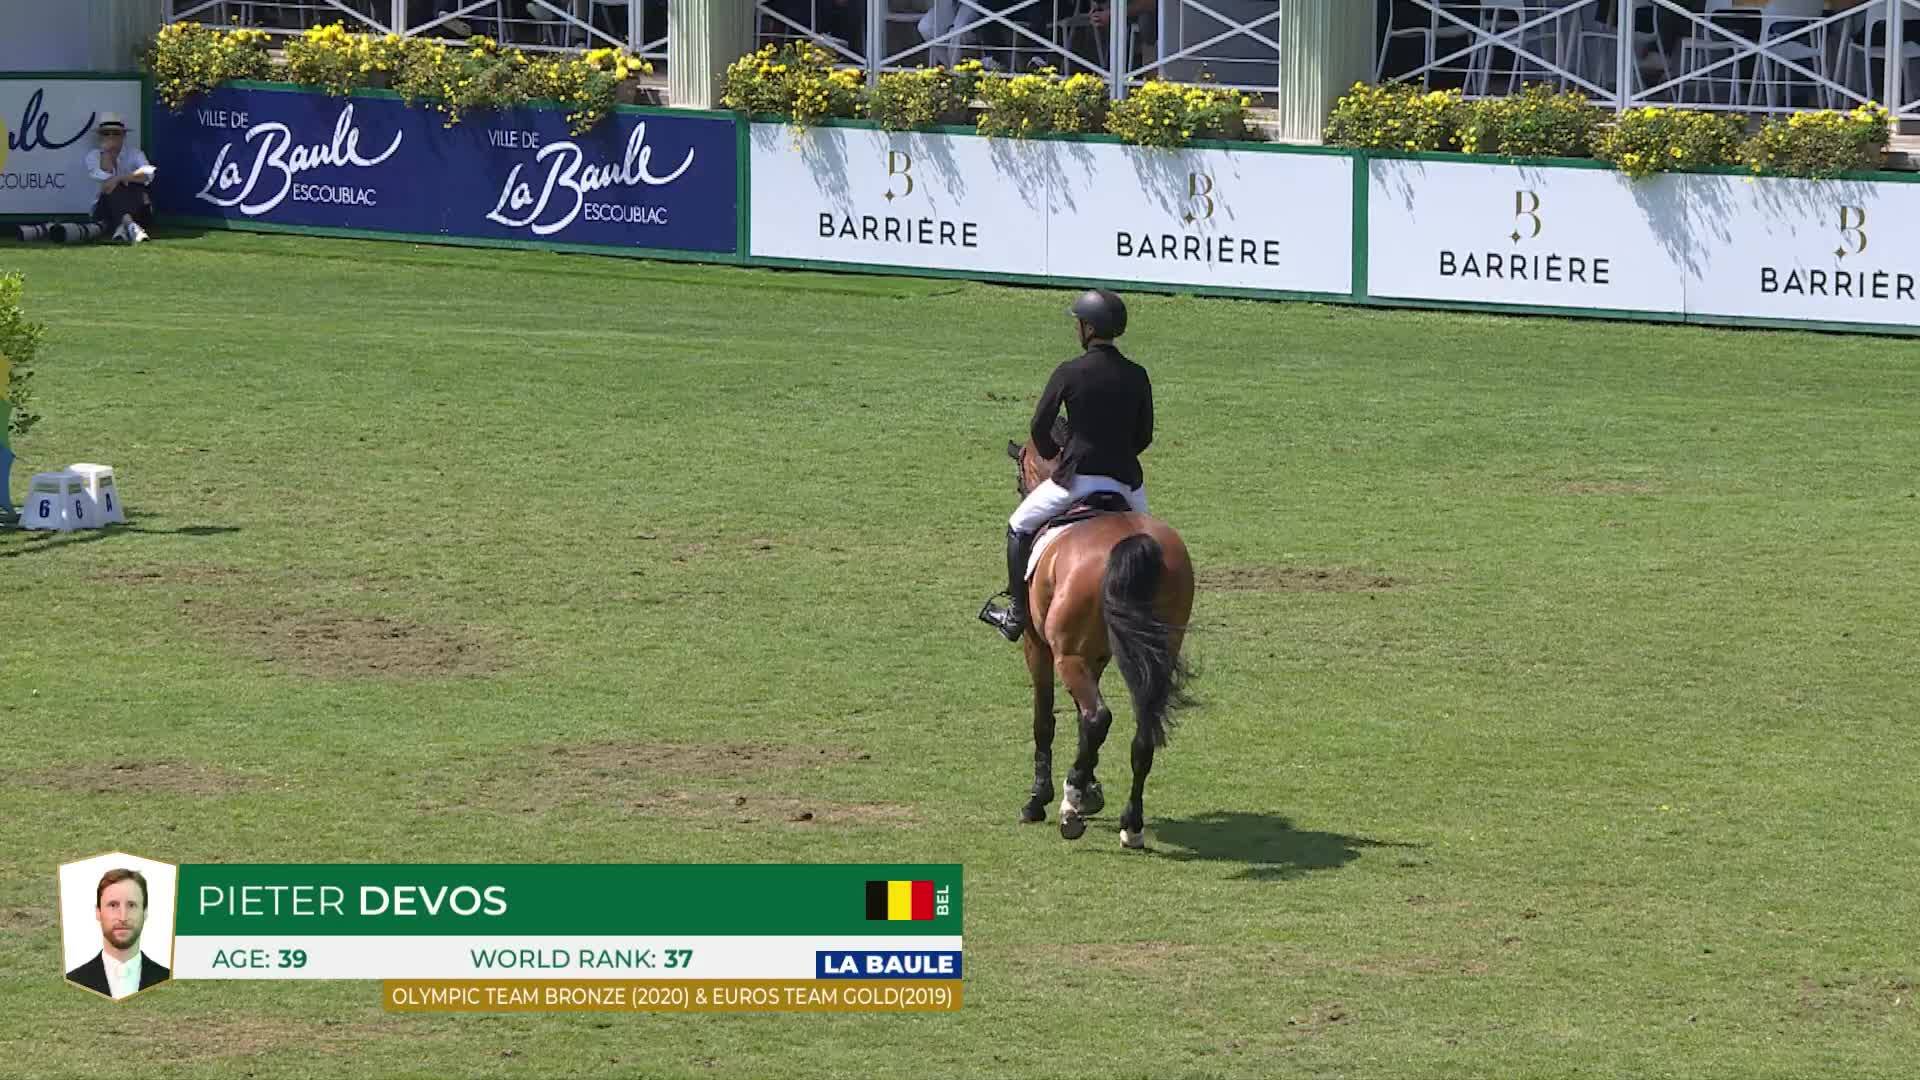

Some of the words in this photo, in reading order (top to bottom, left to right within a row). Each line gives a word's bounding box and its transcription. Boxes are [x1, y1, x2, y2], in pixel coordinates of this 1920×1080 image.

[198, 110, 227, 128] VILLE
[231, 110, 249, 129] DE
[487, 129, 519, 147] VILLE
[521, 130, 540, 148] DE
[195, 142, 243, 207] La
[239, 102, 403, 215] Baule
[485, 163, 535, 227] La
[531, 120, 695, 235] Baule
[292, 183, 377, 207] ESCOUBLAC
[584, 202, 668, 225] ESCOUBLAC
[818, 212, 978, 248] BARRIÈRE
[1115, 231, 1281, 266] BARRIÈRE
[1439, 250, 1610, 284] BARRIÈRE
[1760, 266, 1916, 300] BARRIÈR
[39, 499, 50, 518] 6
